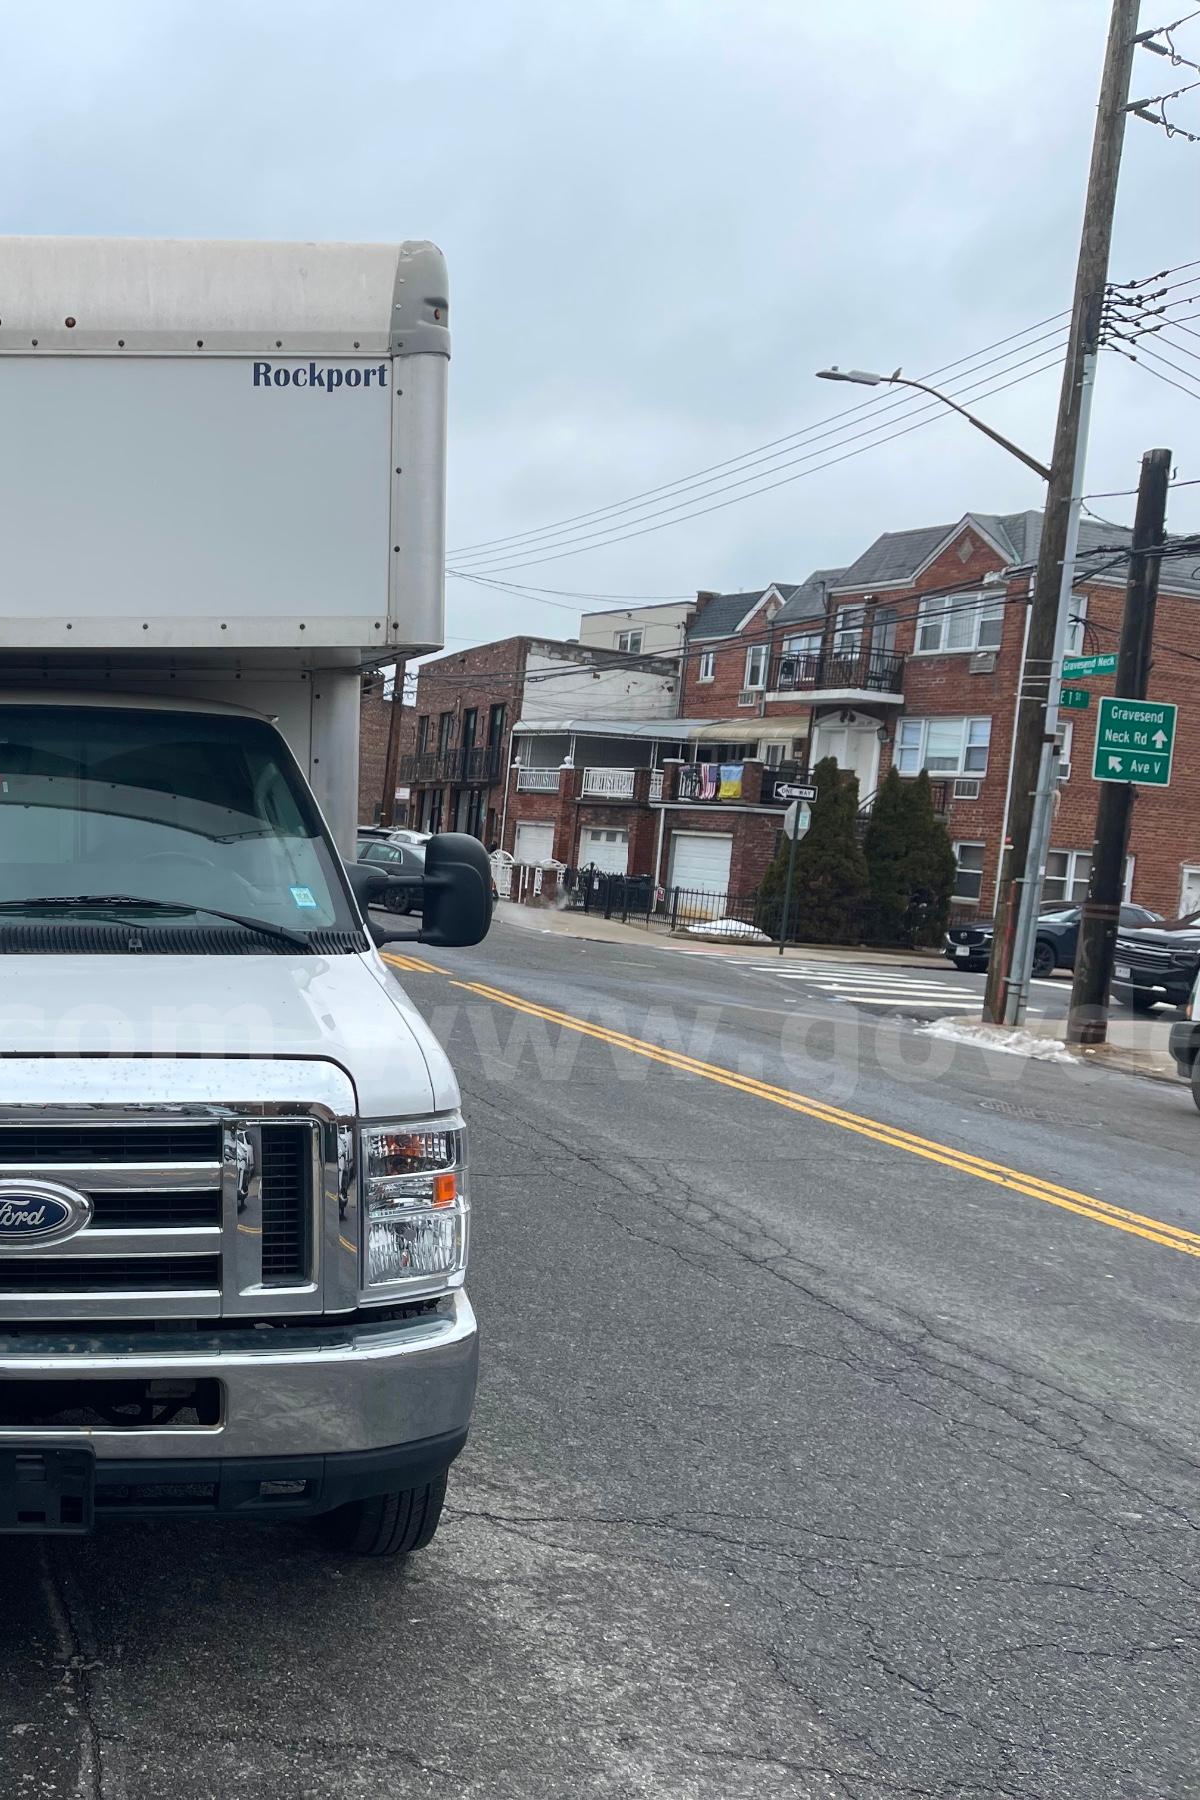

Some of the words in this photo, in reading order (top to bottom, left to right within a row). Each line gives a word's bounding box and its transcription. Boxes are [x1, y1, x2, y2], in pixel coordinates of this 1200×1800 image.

[253, 362, 388, 392] Rockport
[1111, 706, 1164, 723] Gravesend
[1105, 729, 1130, 743] Neck
[1134, 731, 1147, 745] Rd
[1130, 760, 1150, 774] Ave
[1154, 762, 1161, 775] V
